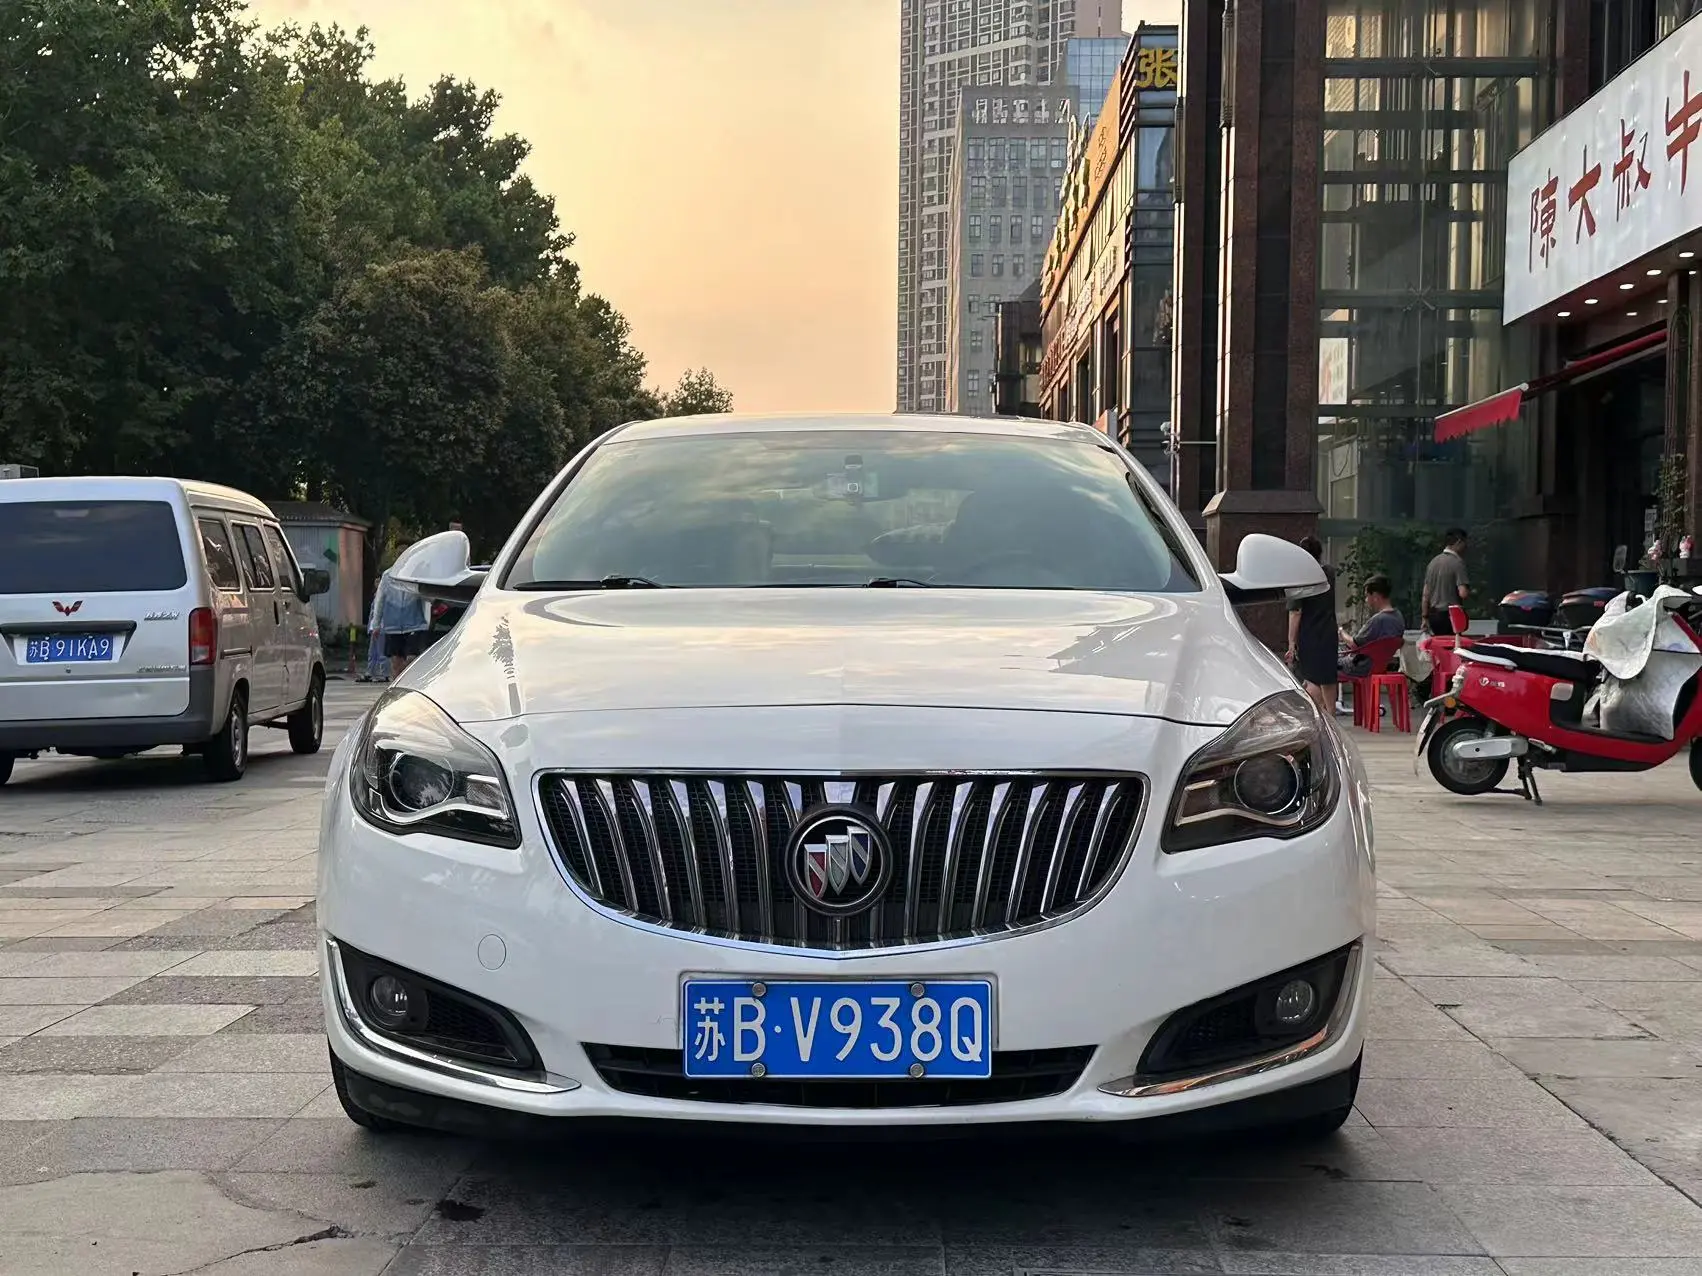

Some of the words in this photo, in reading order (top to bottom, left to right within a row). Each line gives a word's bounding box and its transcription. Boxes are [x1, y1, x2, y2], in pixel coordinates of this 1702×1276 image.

[1135, 48, 1178, 88] 张
[1528, 69, 1702, 273] 陳大叔牛
[693, 996, 983, 1062] 苏B·V938Q
